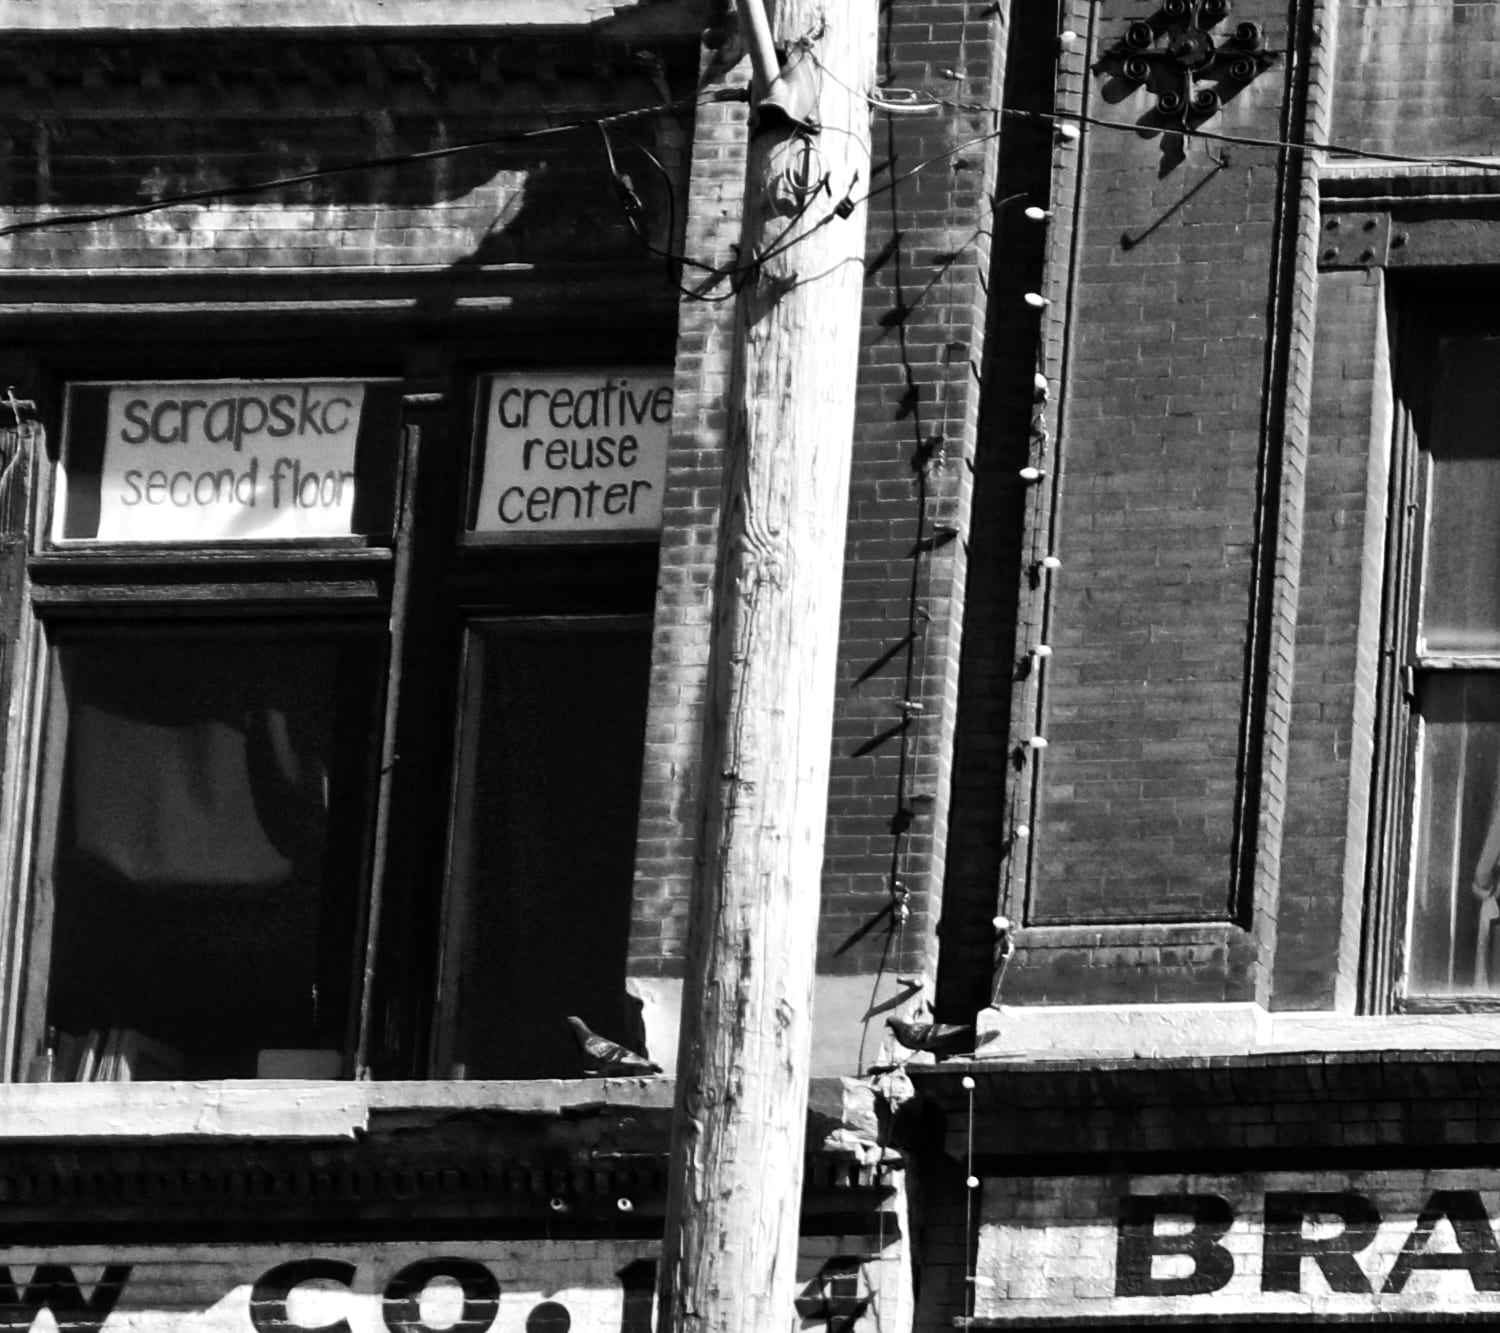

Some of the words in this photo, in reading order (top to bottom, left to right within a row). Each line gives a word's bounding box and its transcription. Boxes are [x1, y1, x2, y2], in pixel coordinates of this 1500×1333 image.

[121, 386, 352, 451] scrapskc
[499, 379, 674, 429] creative
[523, 435, 638, 470] reuse
[121, 456, 258, 507] second
[270, 457, 354, 509] floor
[498, 480, 652, 524] center
